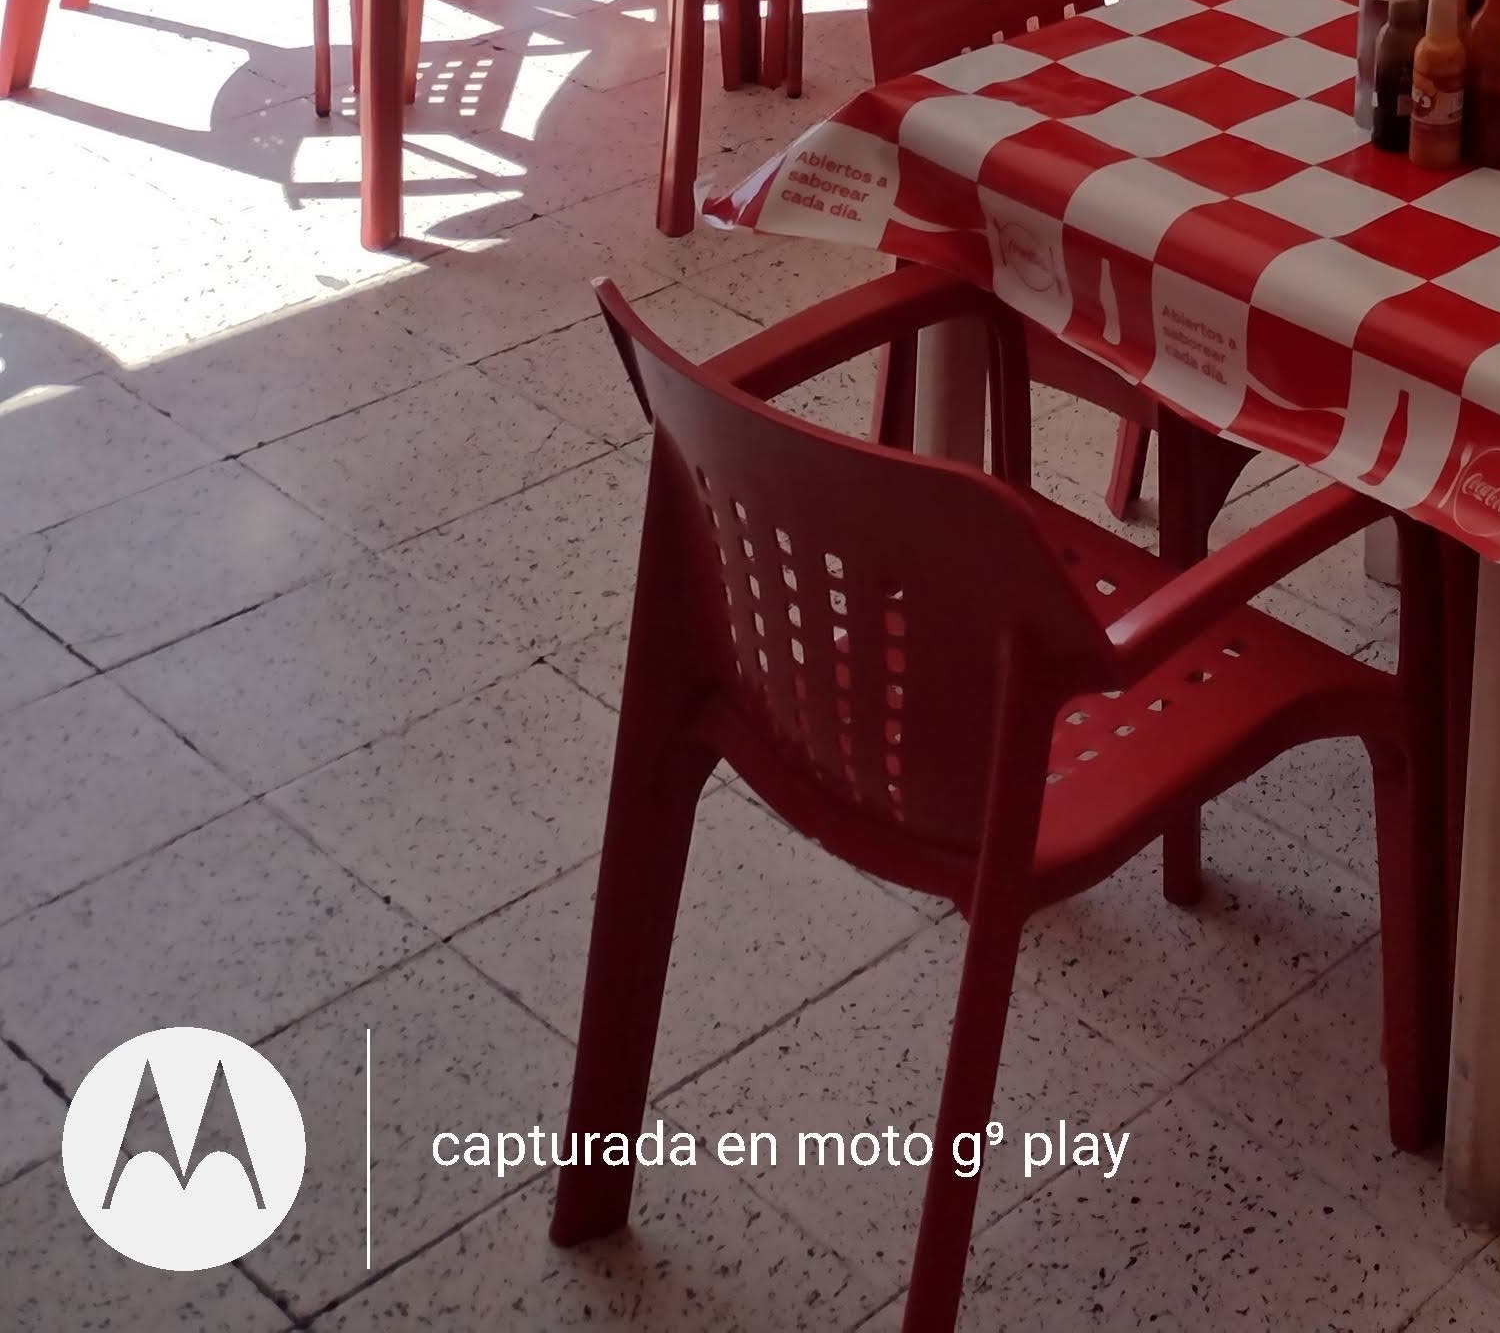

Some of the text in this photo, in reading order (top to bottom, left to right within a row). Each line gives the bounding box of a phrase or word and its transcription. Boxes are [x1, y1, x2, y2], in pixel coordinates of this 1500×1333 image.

[794, 150, 888, 188] Abiertos a
[781, 188, 826, 212] cada
[787, 172, 870, 204] saborear
[1161, 304, 1238, 351] Abiertos a
[1162, 323, 1228, 366] saborear
[1165, 344, 1198, 375] cada
